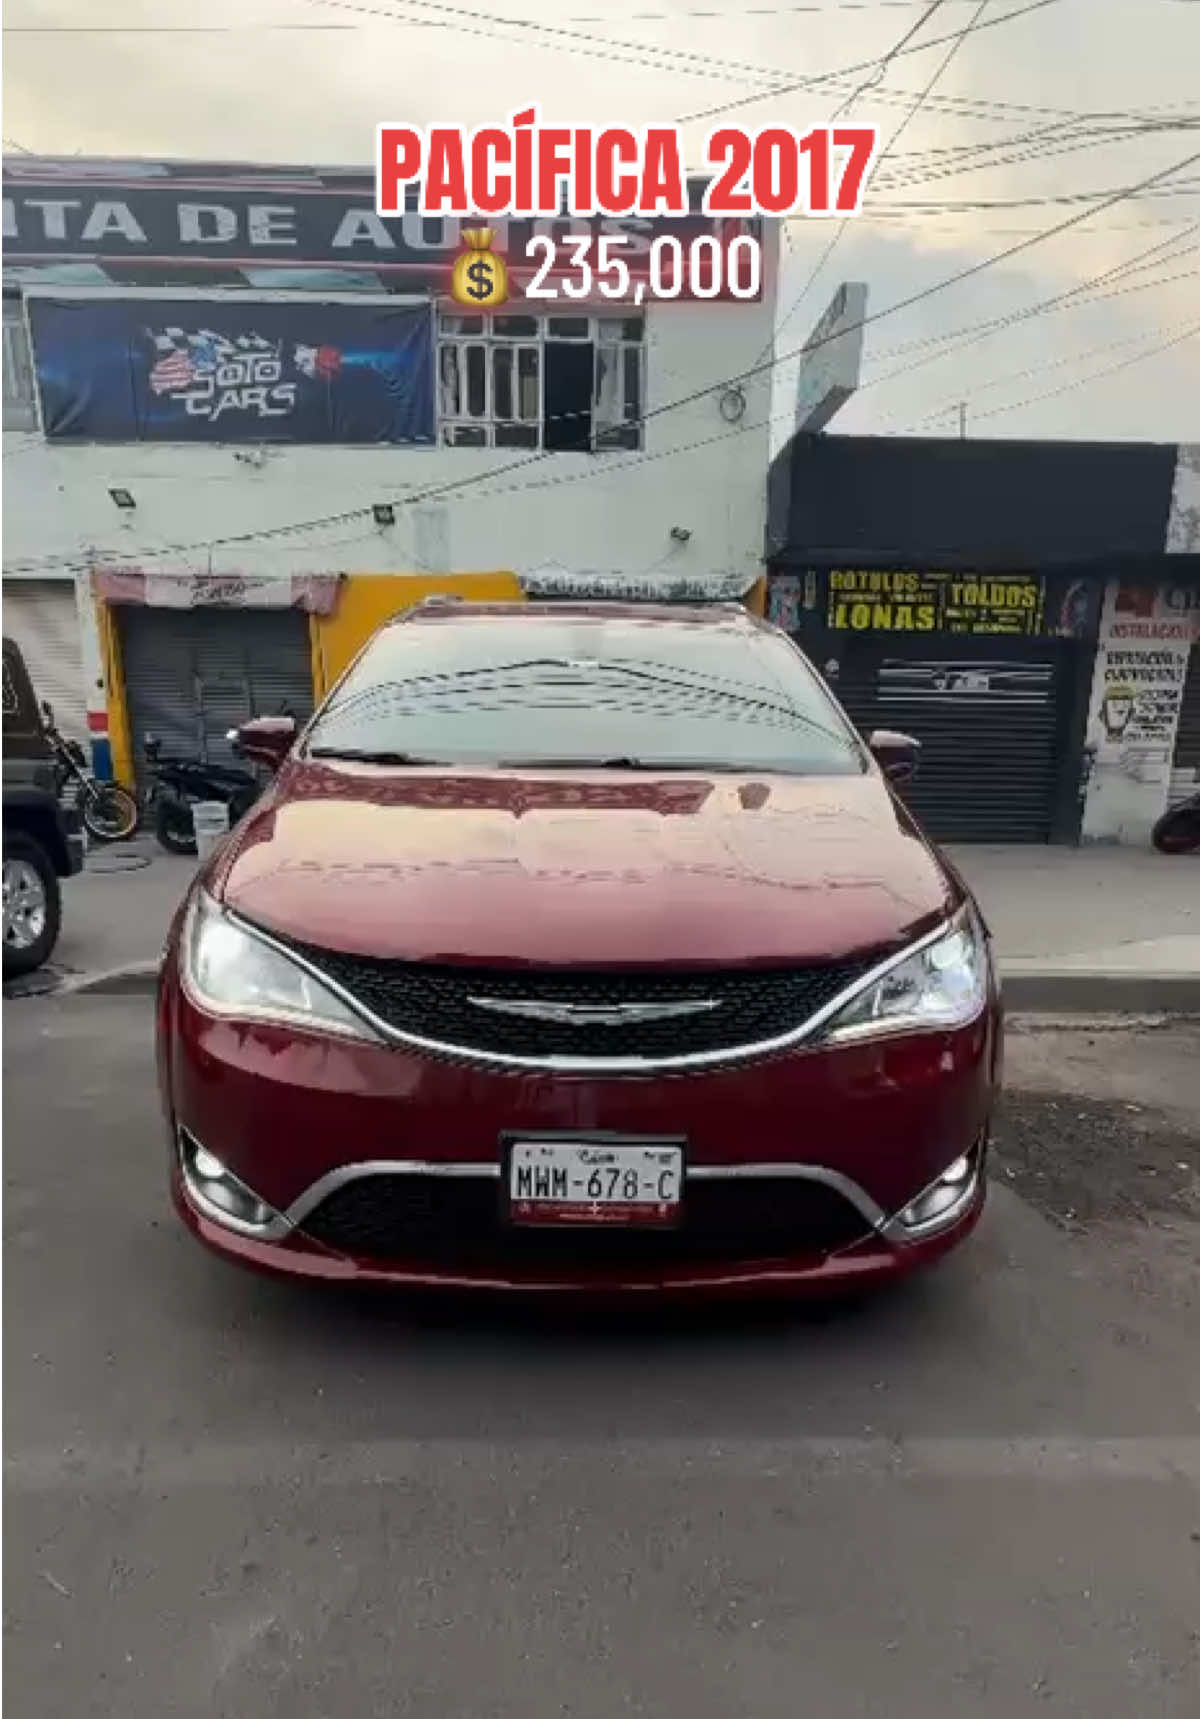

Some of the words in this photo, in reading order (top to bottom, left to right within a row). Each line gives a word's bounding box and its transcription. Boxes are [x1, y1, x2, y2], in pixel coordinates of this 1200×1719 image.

[177, 203, 297, 245] DE
[185, 383, 297, 422] CARS
[952, 583, 1037, 608] TOLDOS
[835, 603, 935, 629] LONAS
[517, 1164, 674, 1200] MWM-678-C
